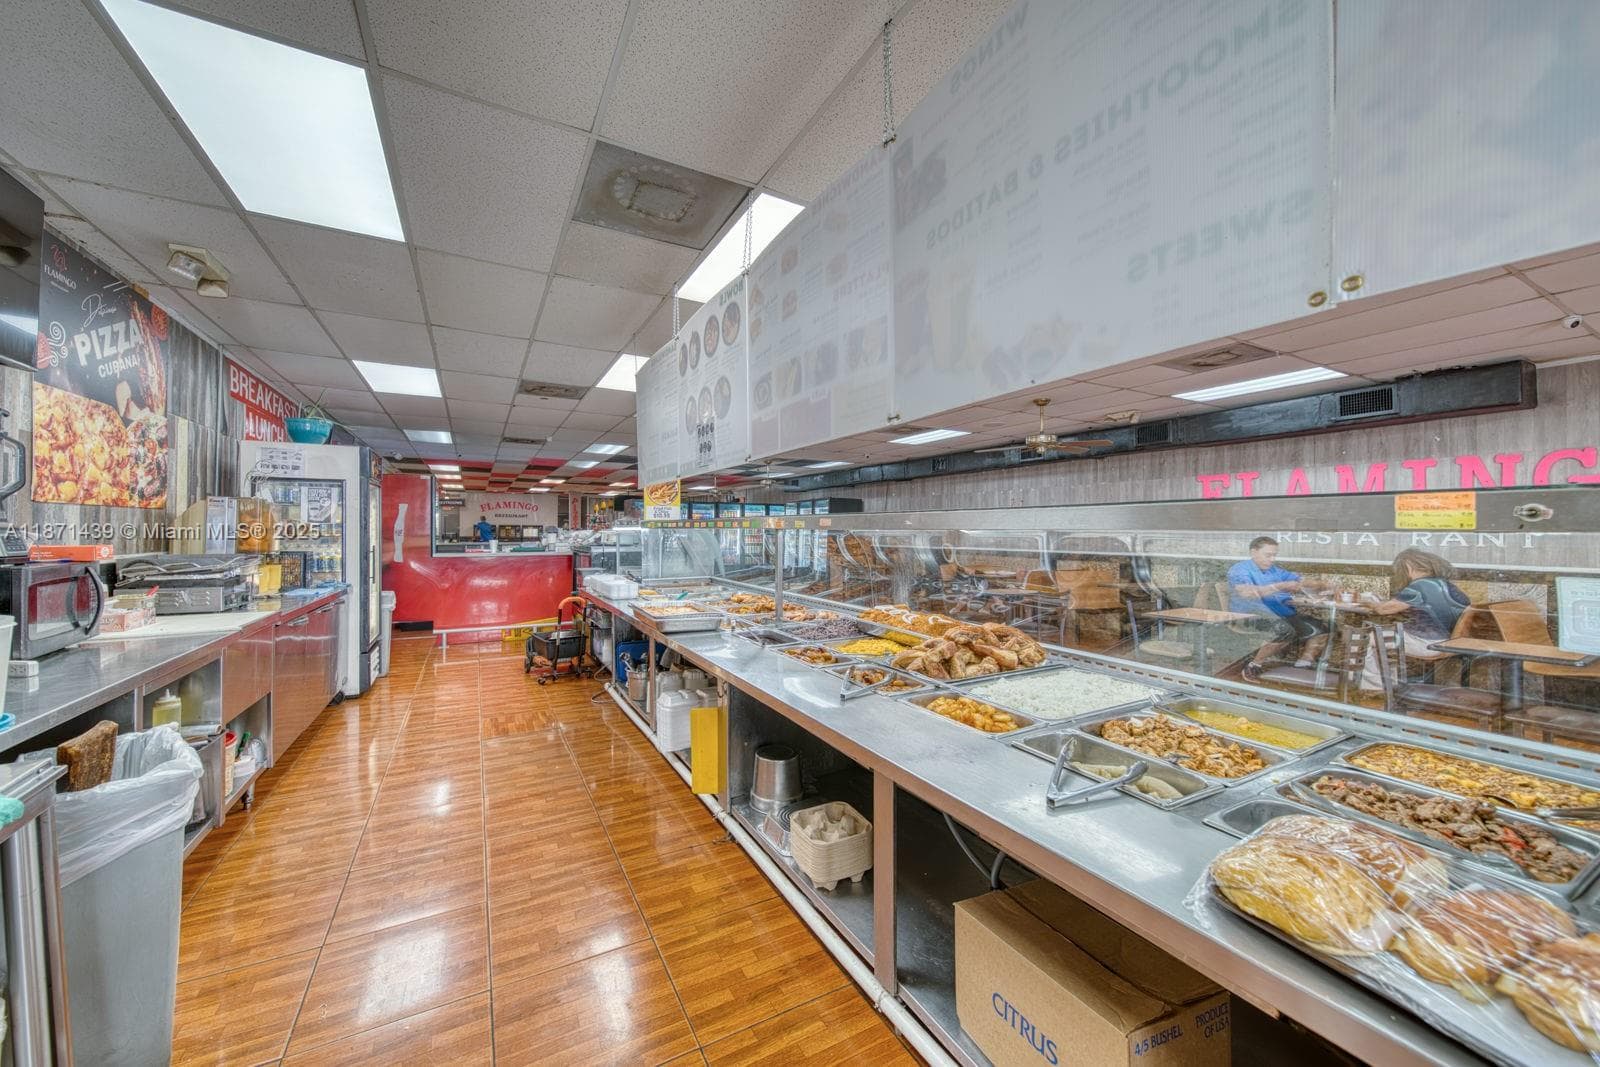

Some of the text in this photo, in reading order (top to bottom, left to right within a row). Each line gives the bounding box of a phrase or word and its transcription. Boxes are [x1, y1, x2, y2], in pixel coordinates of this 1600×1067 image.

[44, 264, 77, 290] FLAMINGO
[73, 318, 144, 367] PIZZA
[249, 412, 284, 442] LUNCH
[480, 500, 539, 512] FLAMINGO
[991, 991, 1060, 1066] CITRUS
[1195, 1003, 1230, 1027] PRODUCE
[1204, 1017, 1230, 1039] OF USA
[1135, 1024, 1184, 1057] 4/5 BUSHEL
